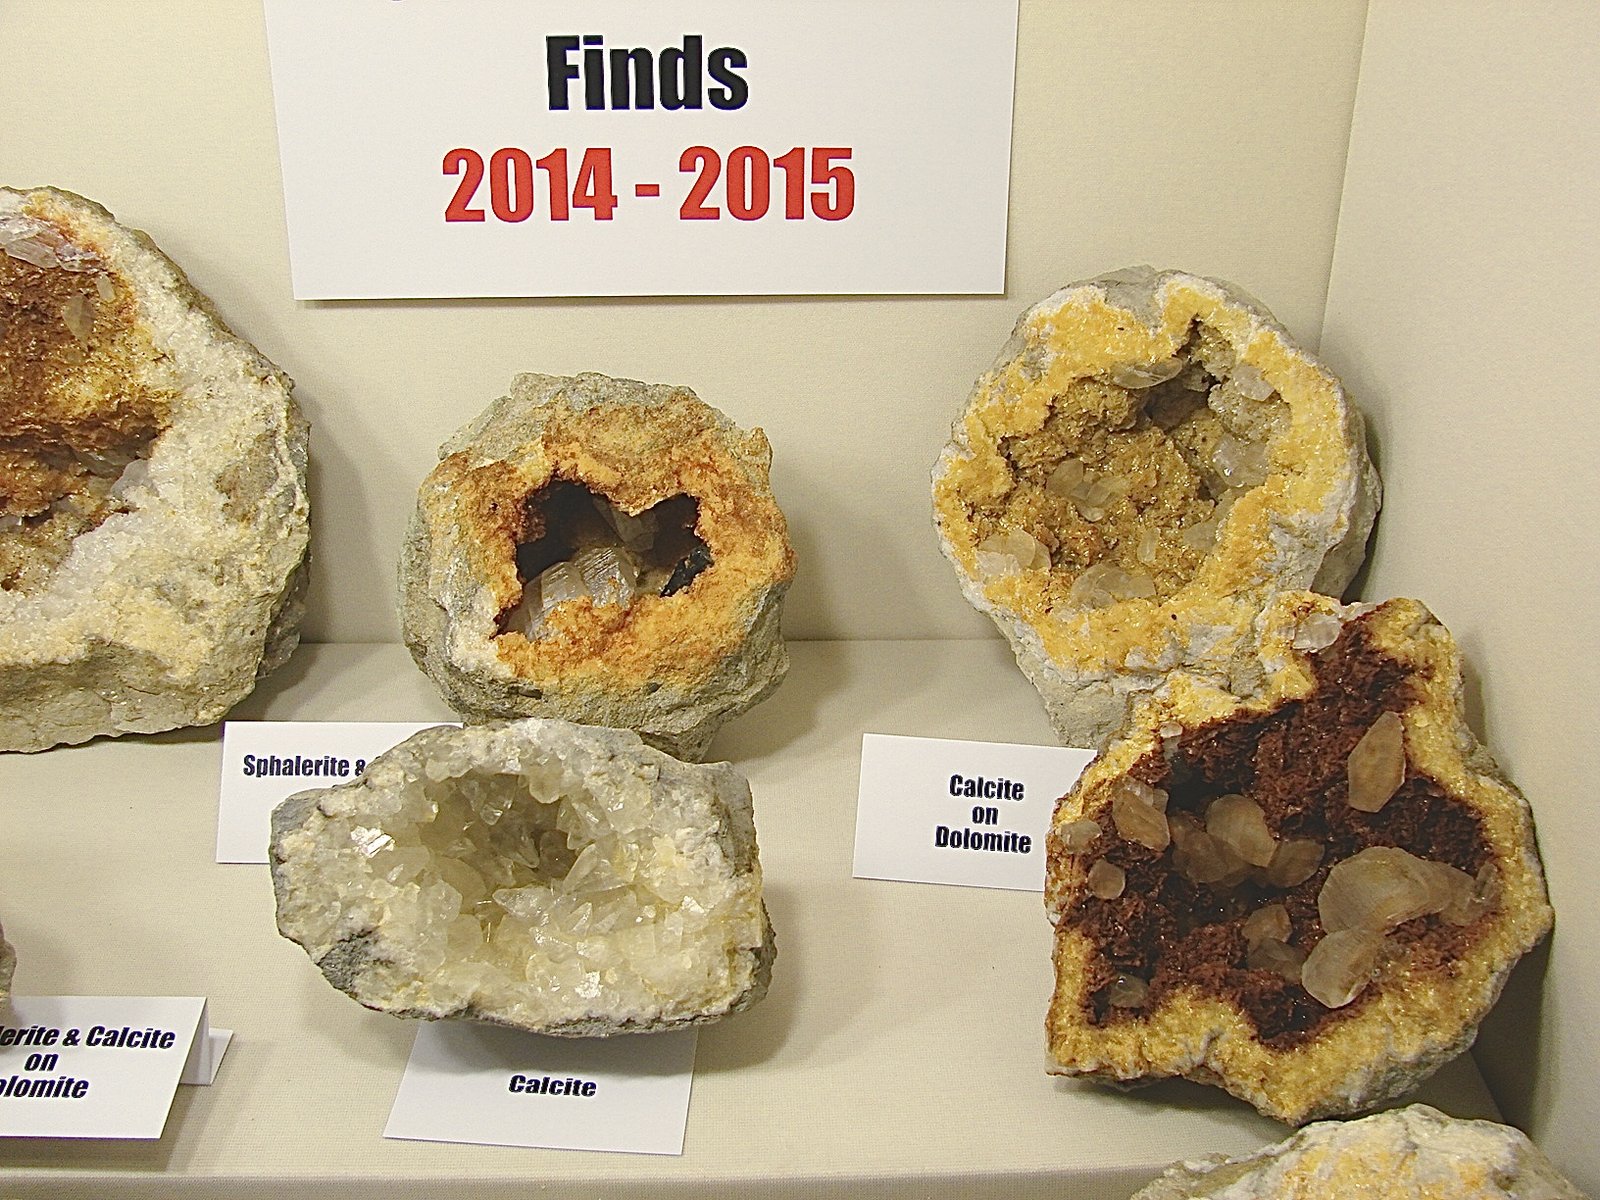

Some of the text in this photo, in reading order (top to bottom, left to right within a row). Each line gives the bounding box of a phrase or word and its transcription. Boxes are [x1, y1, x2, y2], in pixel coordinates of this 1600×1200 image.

[545, 34, 749, 111] Finds
[443, 146, 855, 224] 2014 - 2015
[243, 755, 350, 778] Sphalerite
[949, 774, 1025, 802] Calcite
[972, 805, 999, 825] on
[934, 824, 1032, 854] Dolomite
[0, 1025, 176, 1049] erite & Calcite
[23, 1053, 59, 1072] on
[508, 1074, 597, 1097] Calcite
